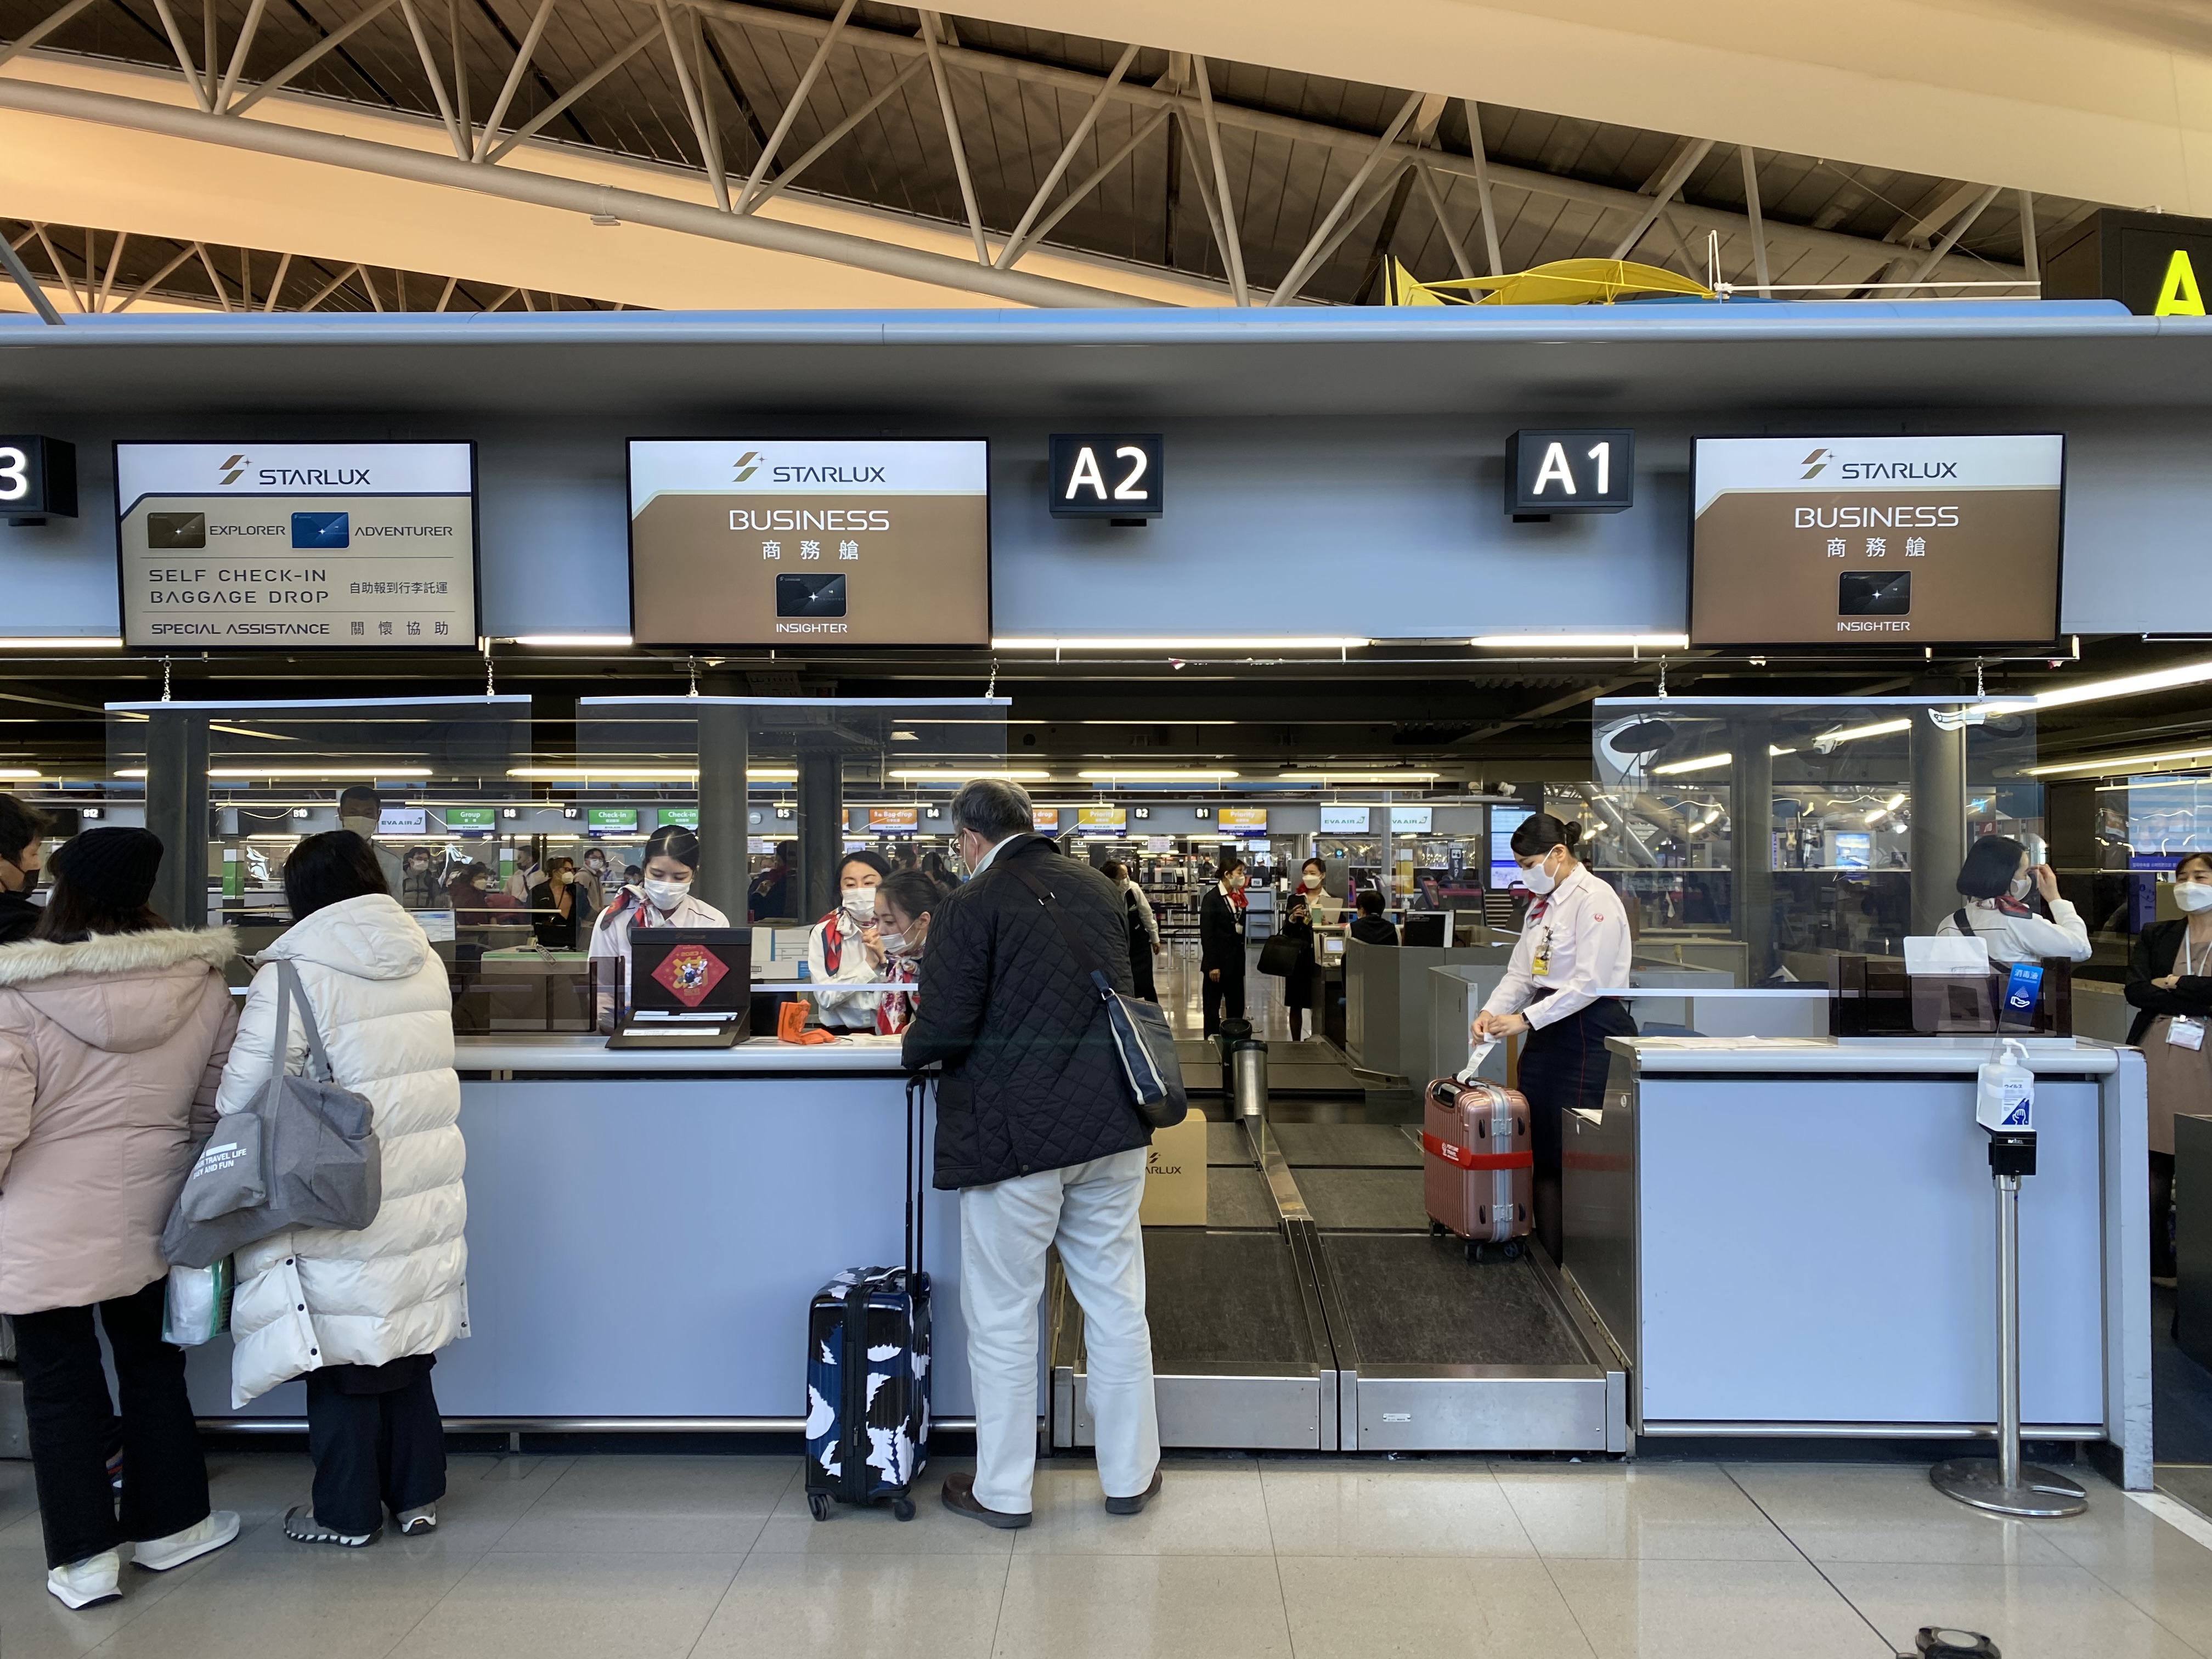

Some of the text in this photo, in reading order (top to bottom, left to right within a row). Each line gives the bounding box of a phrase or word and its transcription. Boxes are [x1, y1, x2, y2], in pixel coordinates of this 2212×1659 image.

[2155, 250, 2205, 316] A
[773, 466, 886, 483] STARLUX
[1065, 446, 1148, 500] A2
[1533, 442, 1609, 495] A1
[1842, 462, 1958, 479] STARLUX
[259, 469, 371, 485] STARLUX
[729, 510, 890, 531] BUSINESS
[1795, 506, 1959, 528] BUSINESS
[209, 525, 286, 536] EXPLORER
[354, 526, 453, 537] ADVENTURER
[761, 539, 859, 560] 商務艙
[1827, 537, 1927, 558] 商務艙
[149, 569, 326, 582] SELF CHECK-IN
[349, 582, 448, 594] 自助報到行李託運
[150, 590, 329, 603] BAGGAGE DROP
[151, 624, 330, 635] SPECIAL ASSISTANCE
[351, 620, 449, 636] 關懷協助
[776, 623, 848, 634] INSIGHTER
[1837, 621, 1911, 632] INSIGHTER
[565, 809, 577, 817] B7
[777, 809, 790, 818] B5
[927, 809, 939, 817] B4
[1136, 808, 1149, 818] B2
[1197, 808, 1209, 817] B1
[205, 1152, 230, 1165] TRAVEL
[232, 1148, 247, 1158] LIFE
[204, 1164, 218, 1173] AND
[218, 1159, 234, 1170] FUN
